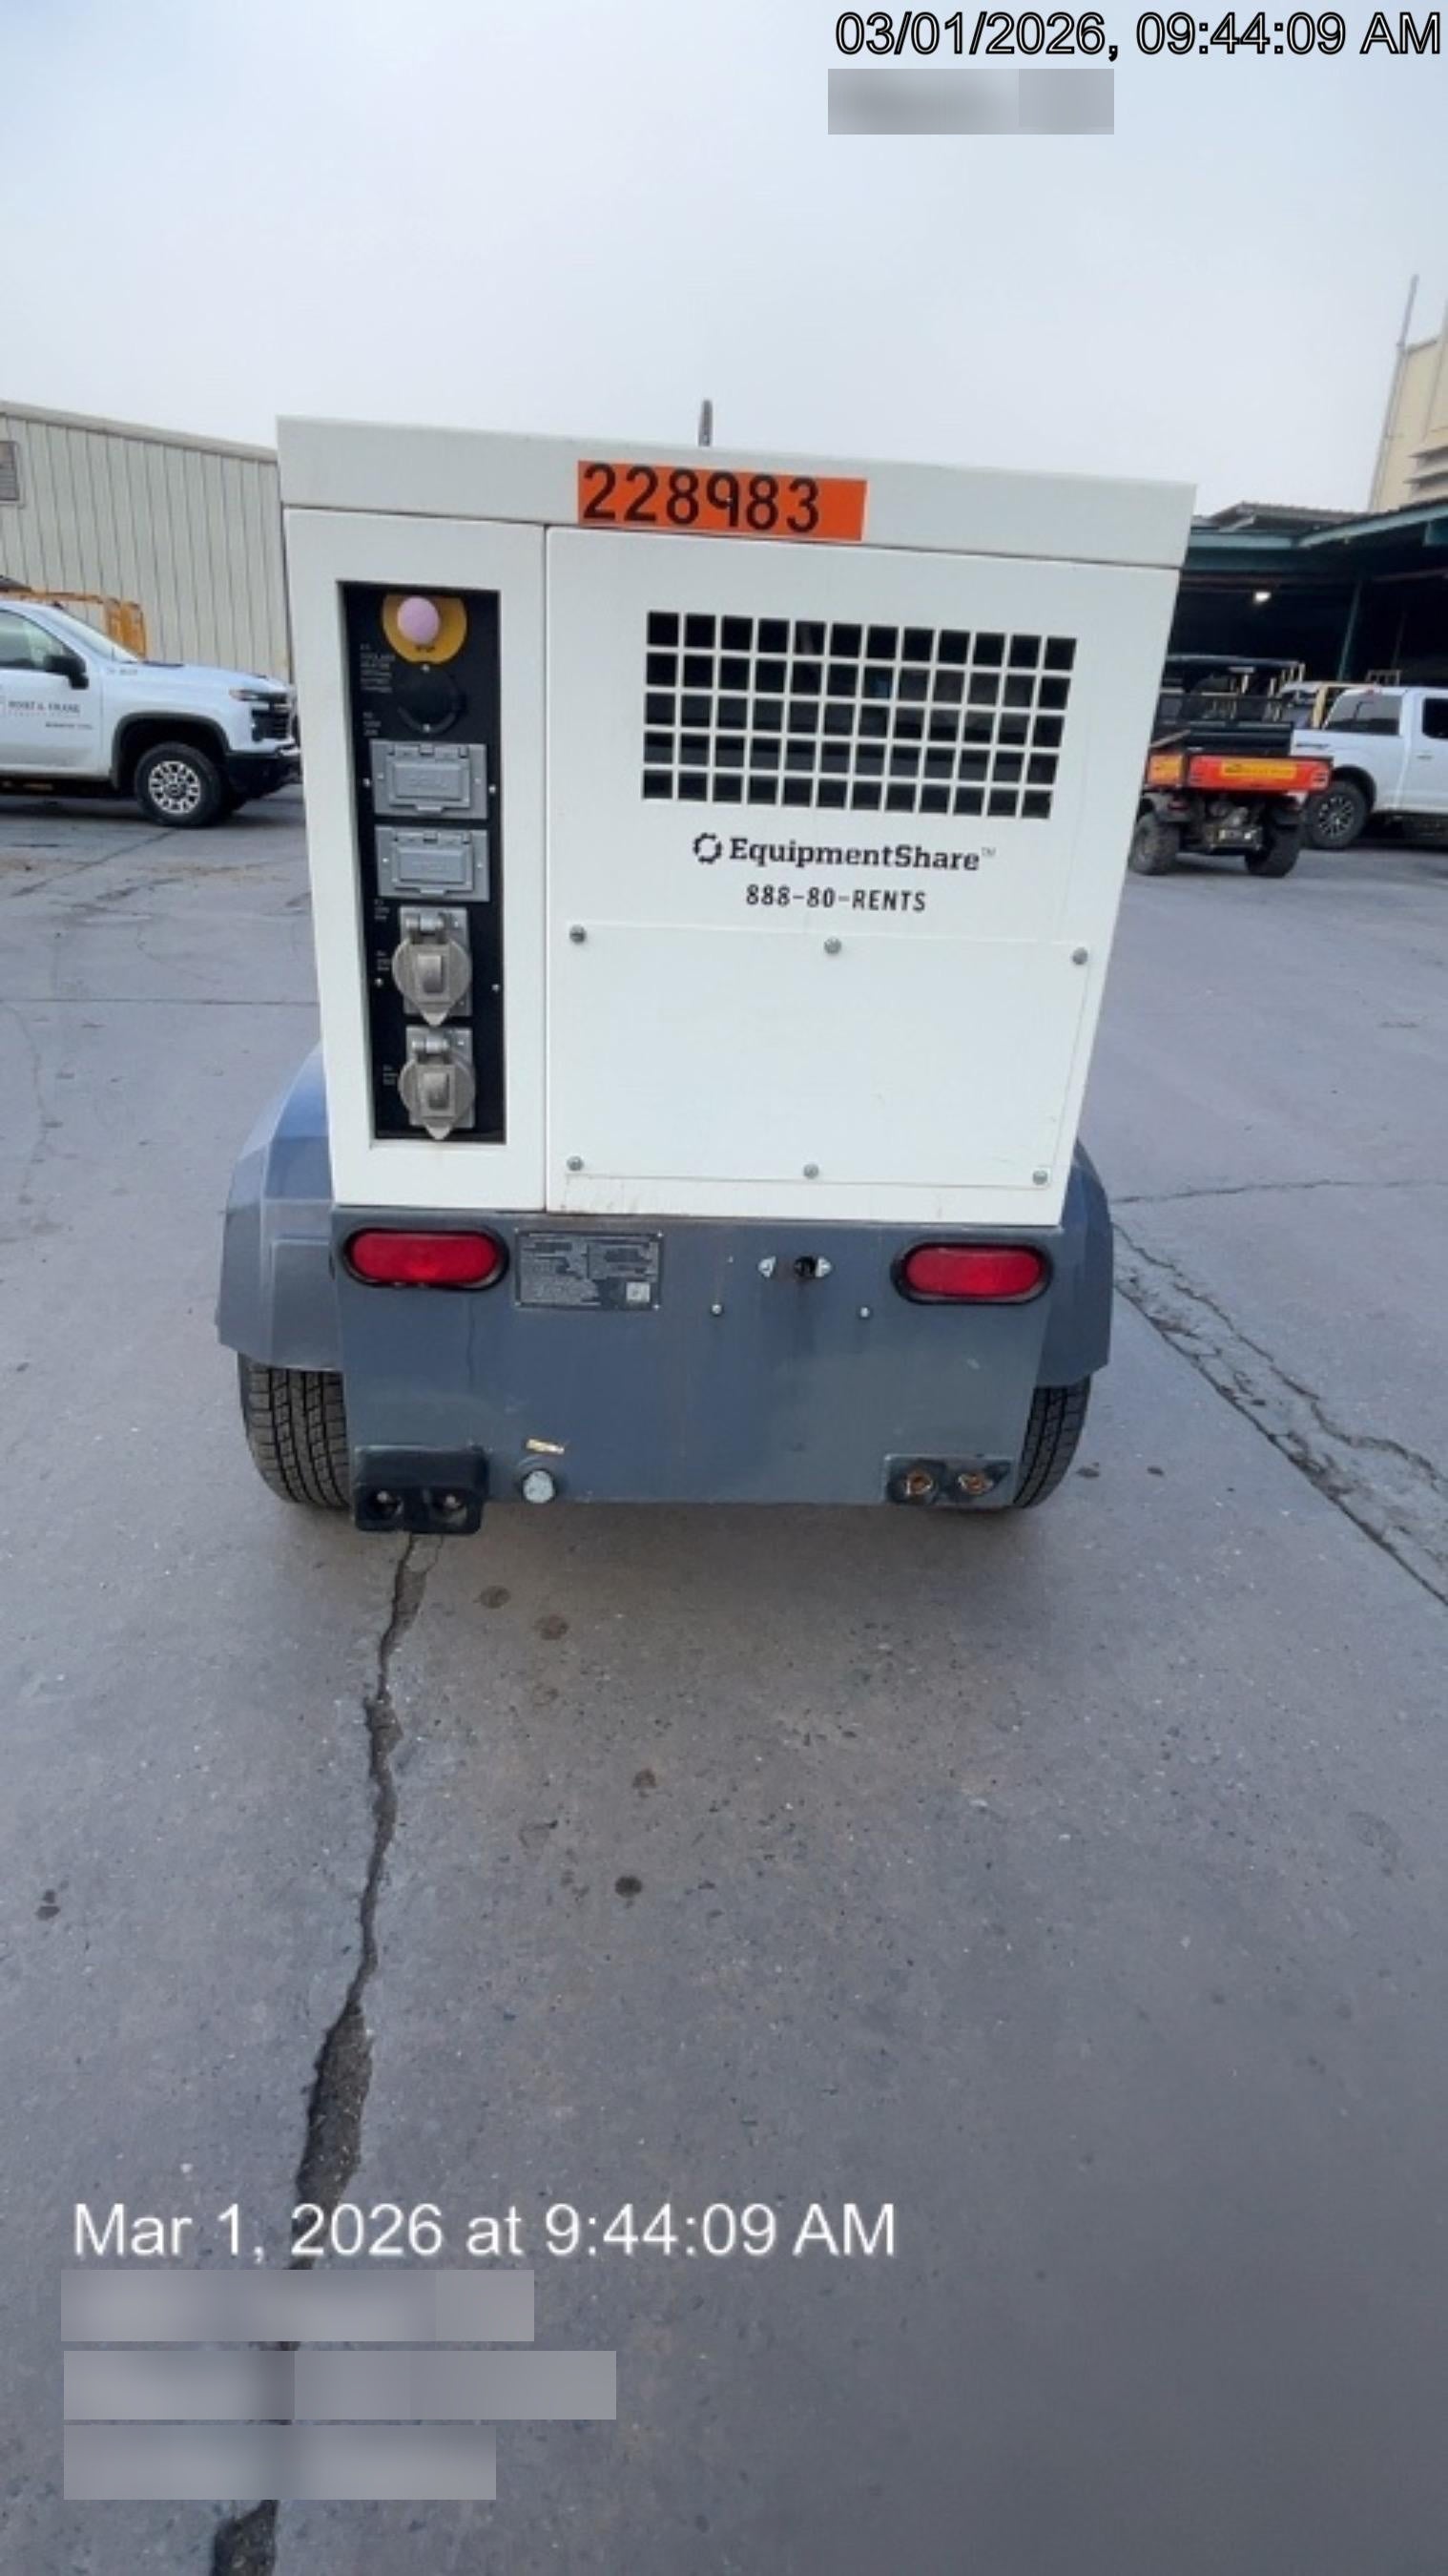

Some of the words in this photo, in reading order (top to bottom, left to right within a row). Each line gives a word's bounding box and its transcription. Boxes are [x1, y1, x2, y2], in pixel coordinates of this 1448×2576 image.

[583, 463, 819, 533] 228983
[729, 837, 981, 871] EquipmentShare
[745, 883, 927, 912] 888-80-RENTS
